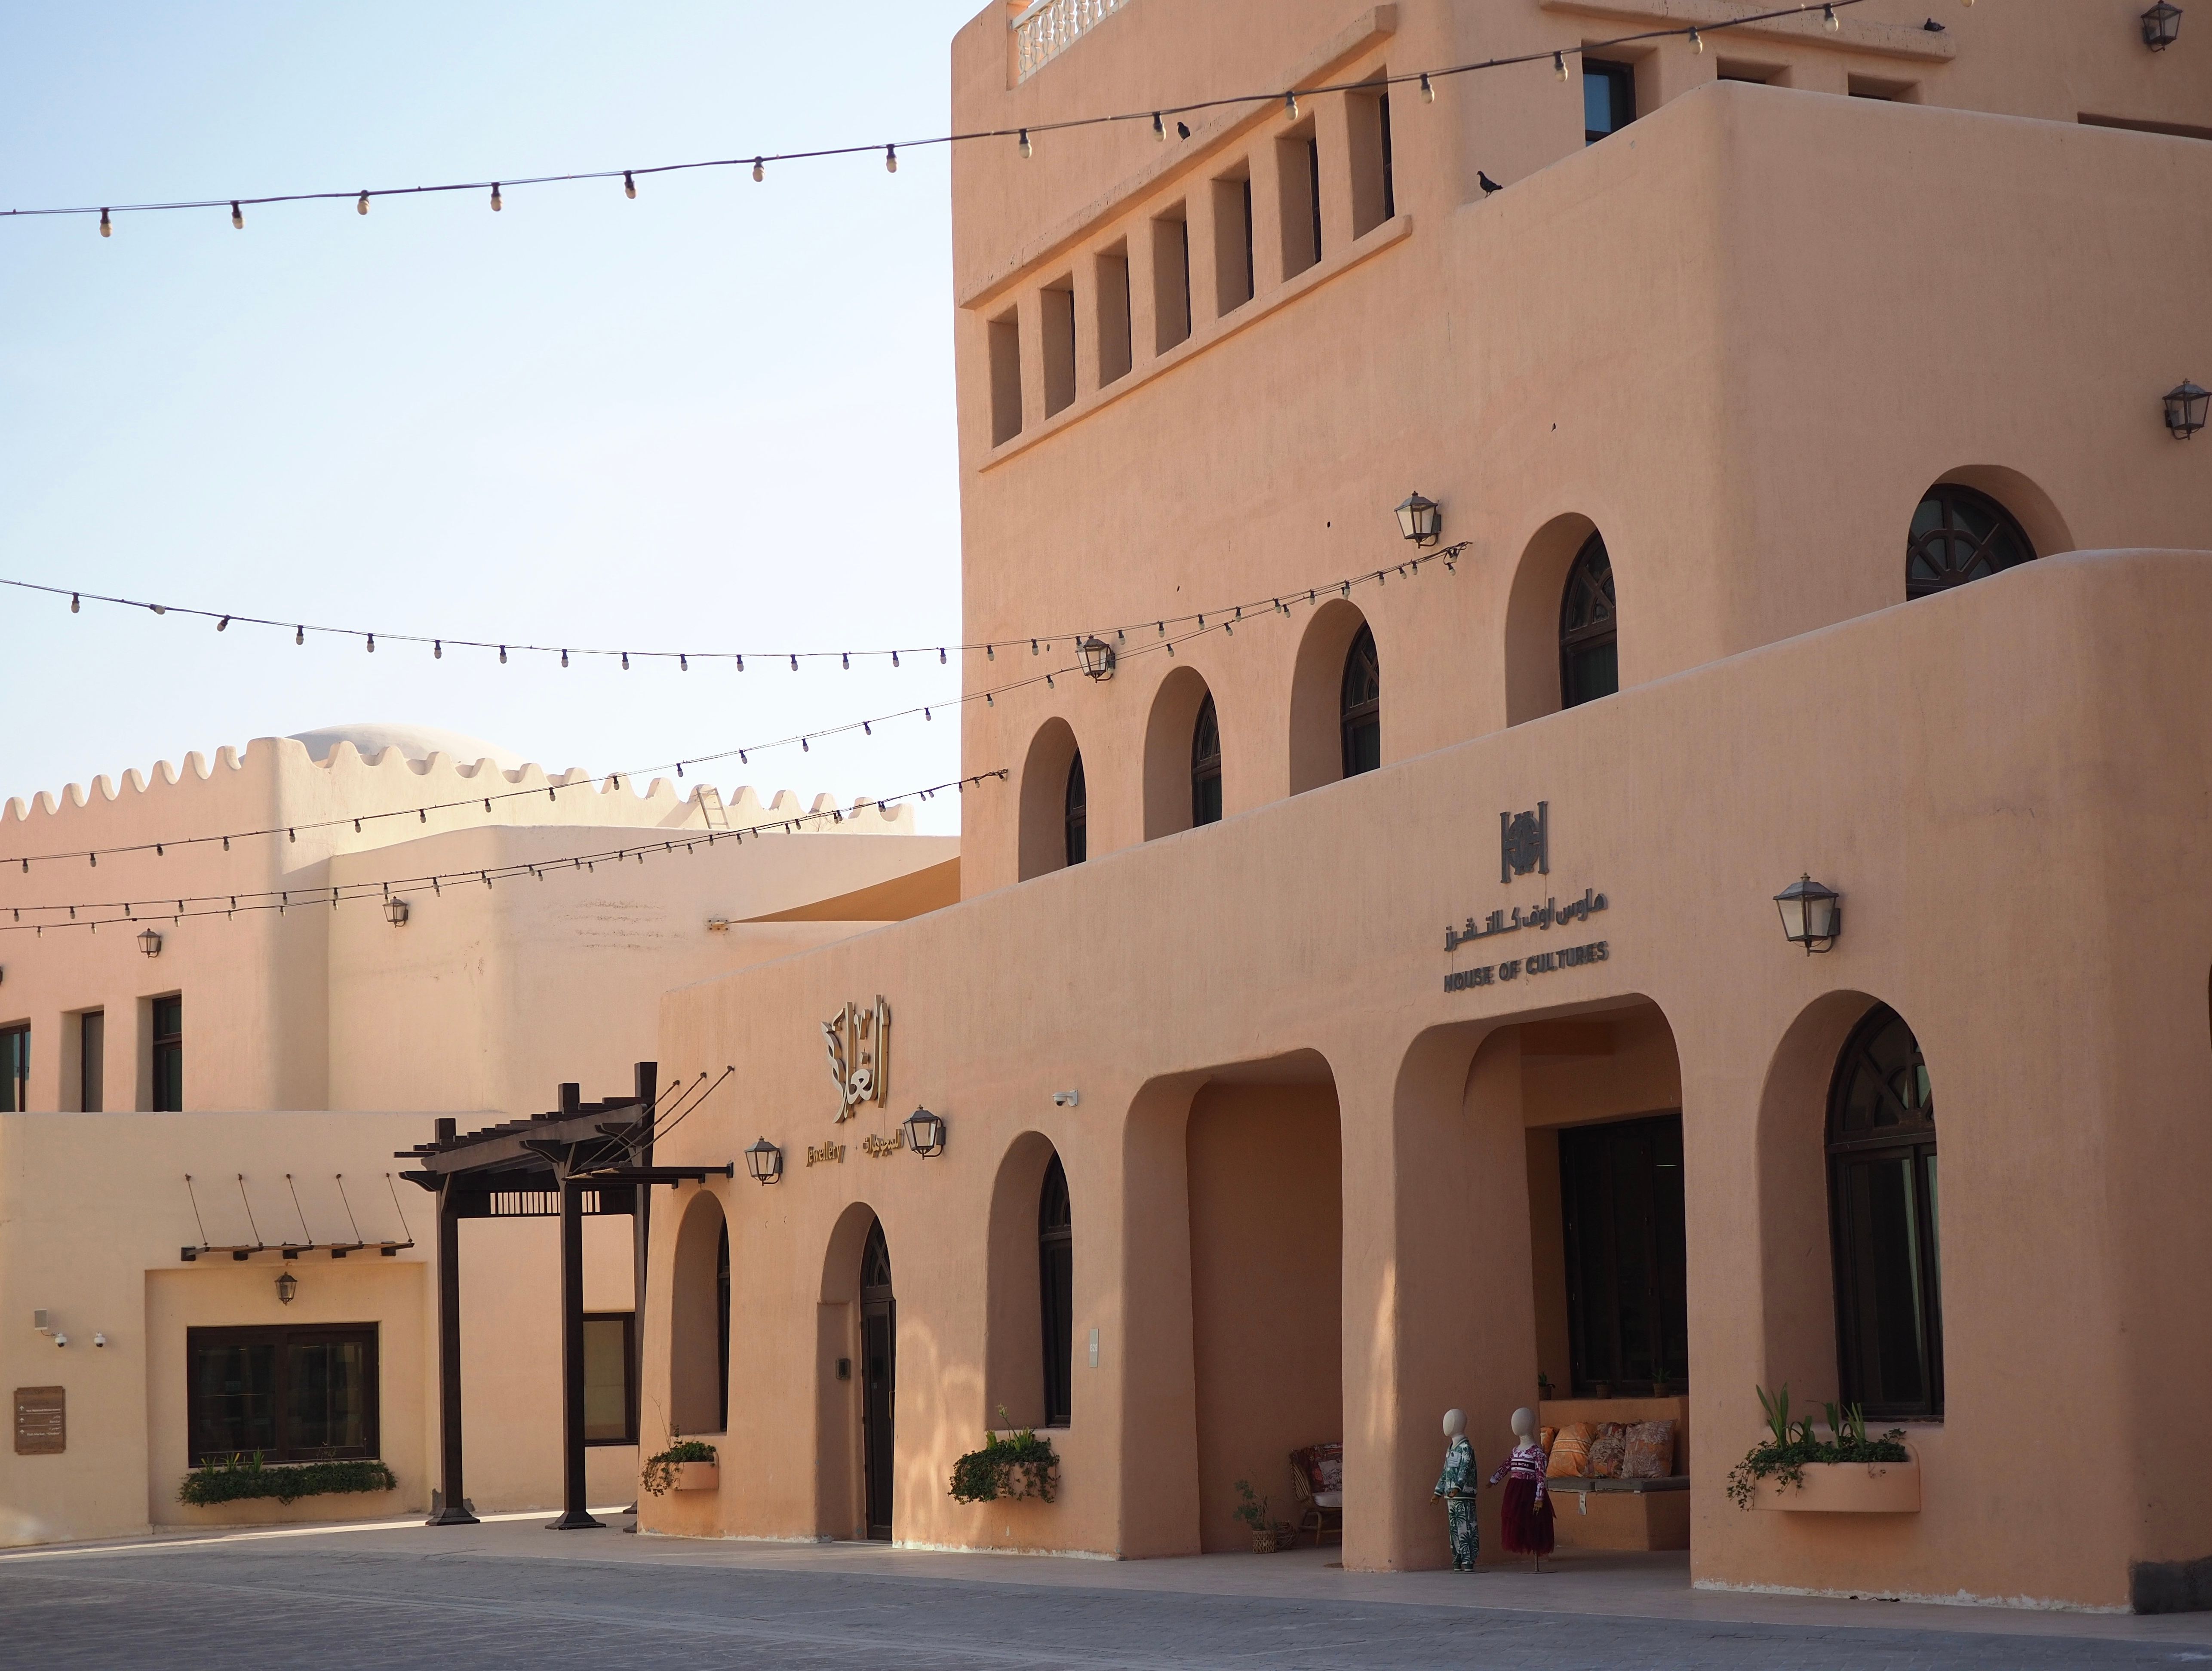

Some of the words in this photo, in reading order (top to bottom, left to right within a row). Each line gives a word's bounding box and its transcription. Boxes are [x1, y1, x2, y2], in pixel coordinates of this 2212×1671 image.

[1444, 966, 1494, 992] HOUSE
[1499, 960, 1522, 981] OF
[1526, 941, 1609, 975] CULTURES
[806, 1141, 846, 1167] Jewellery
[863, 1129, 904, 1158] للمجوهرات
